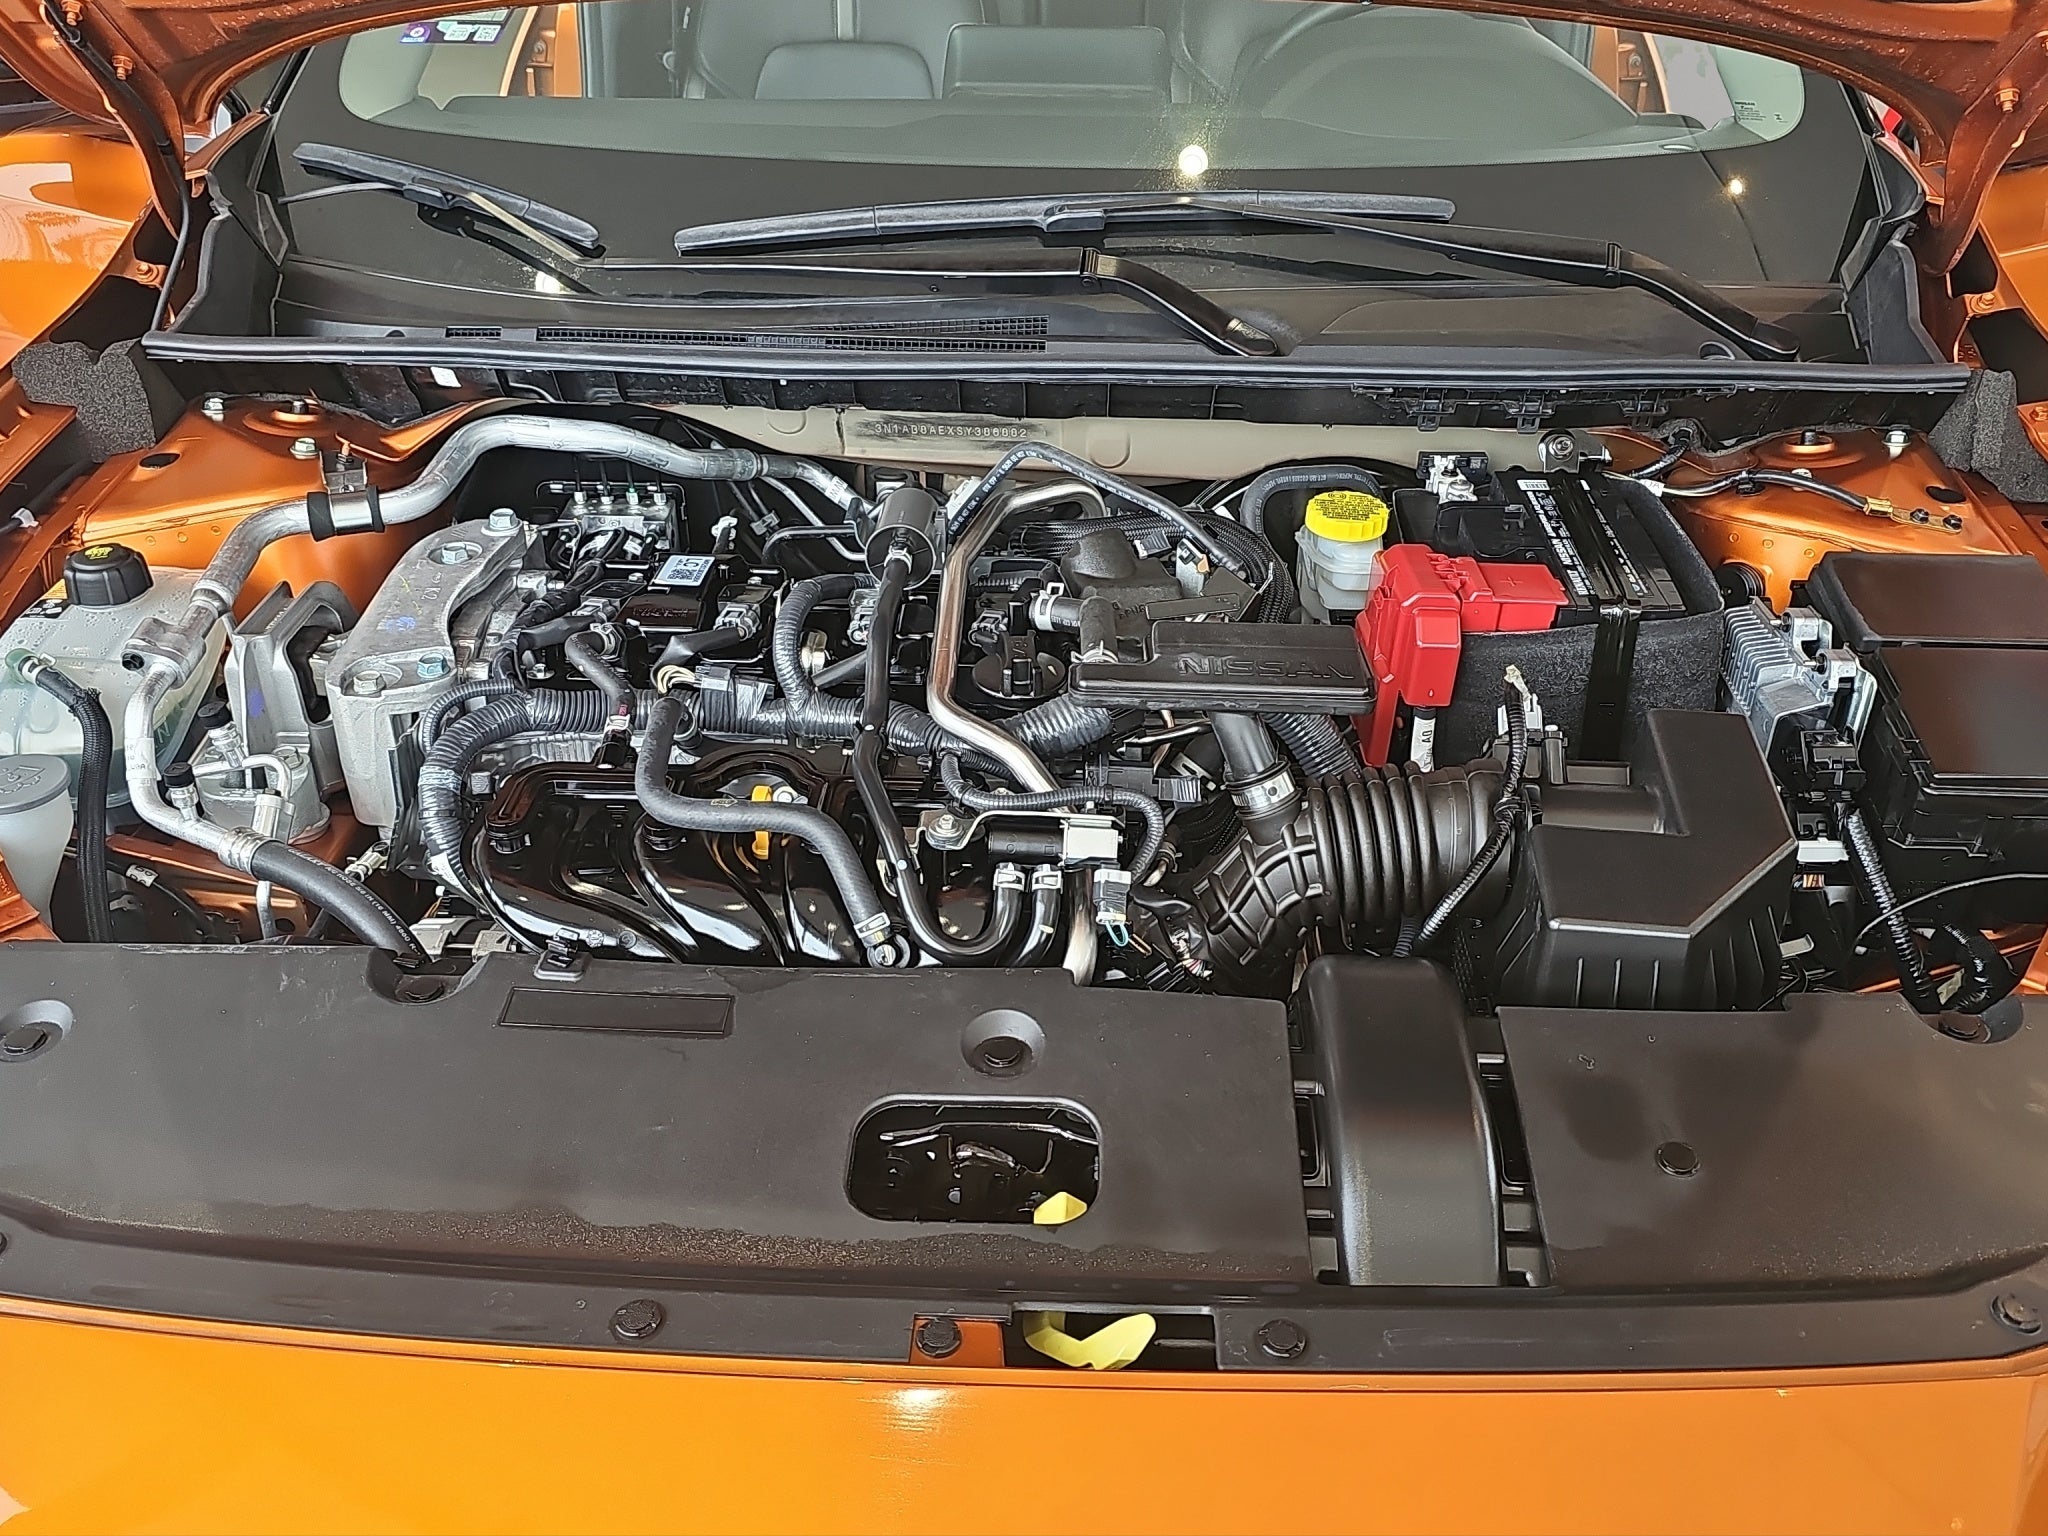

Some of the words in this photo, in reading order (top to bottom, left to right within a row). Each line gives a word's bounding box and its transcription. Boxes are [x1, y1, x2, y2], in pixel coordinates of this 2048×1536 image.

[1550, 538, 1574, 566] NISSAN
[1177, 654, 1356, 680] NISSAN
[337, 873, 356, 886] HOSE
